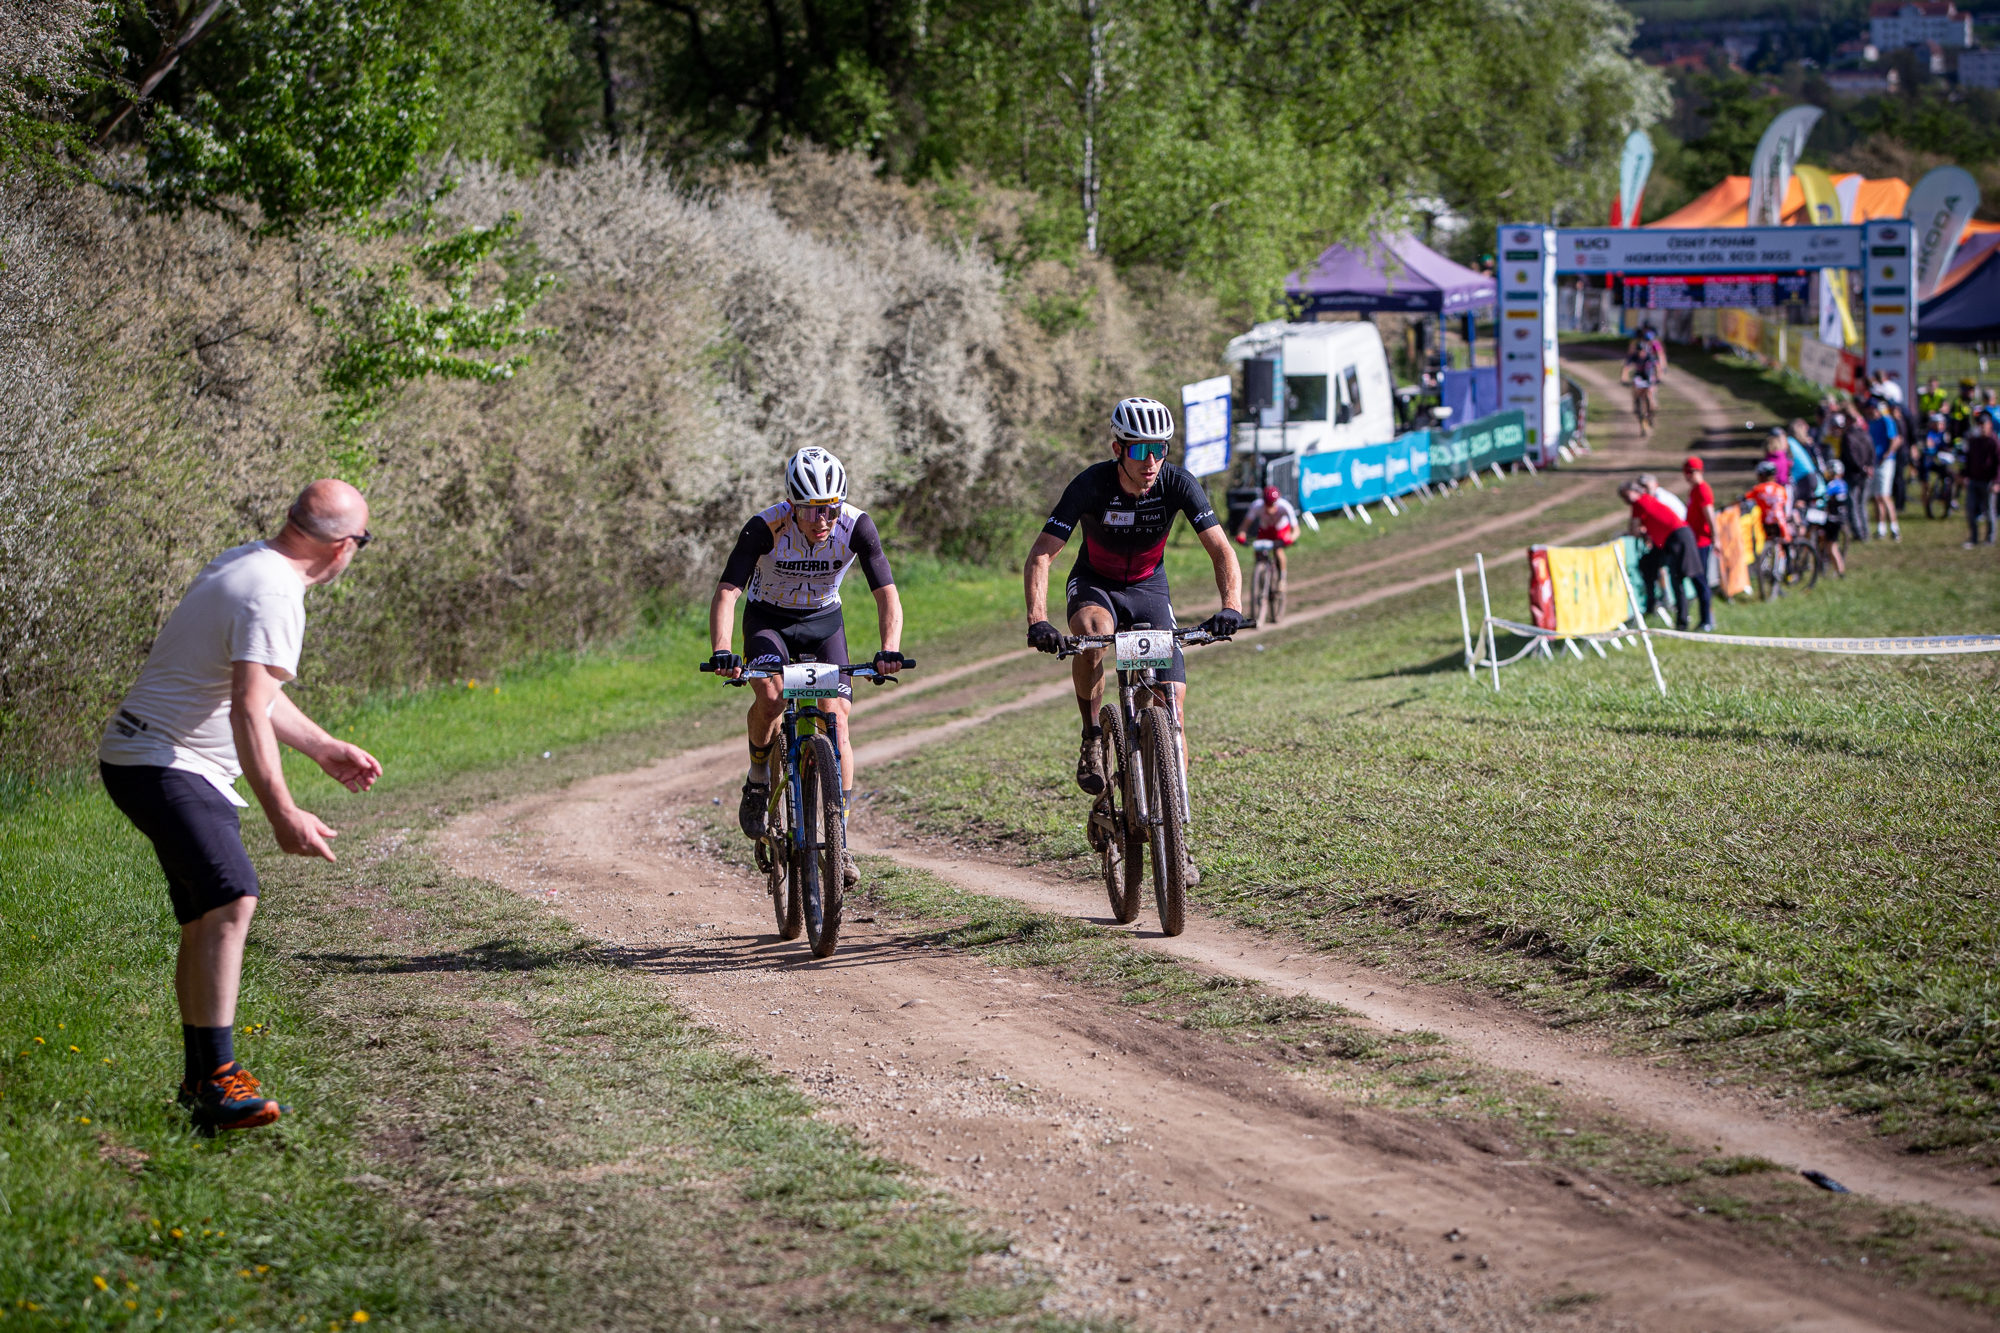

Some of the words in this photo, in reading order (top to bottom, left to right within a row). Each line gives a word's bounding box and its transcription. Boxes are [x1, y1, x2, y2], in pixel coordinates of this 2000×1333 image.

[774, 560, 830, 572] SUBTERRA
[1138, 638, 1150, 656] 9
[805, 668, 817, 686] 3
